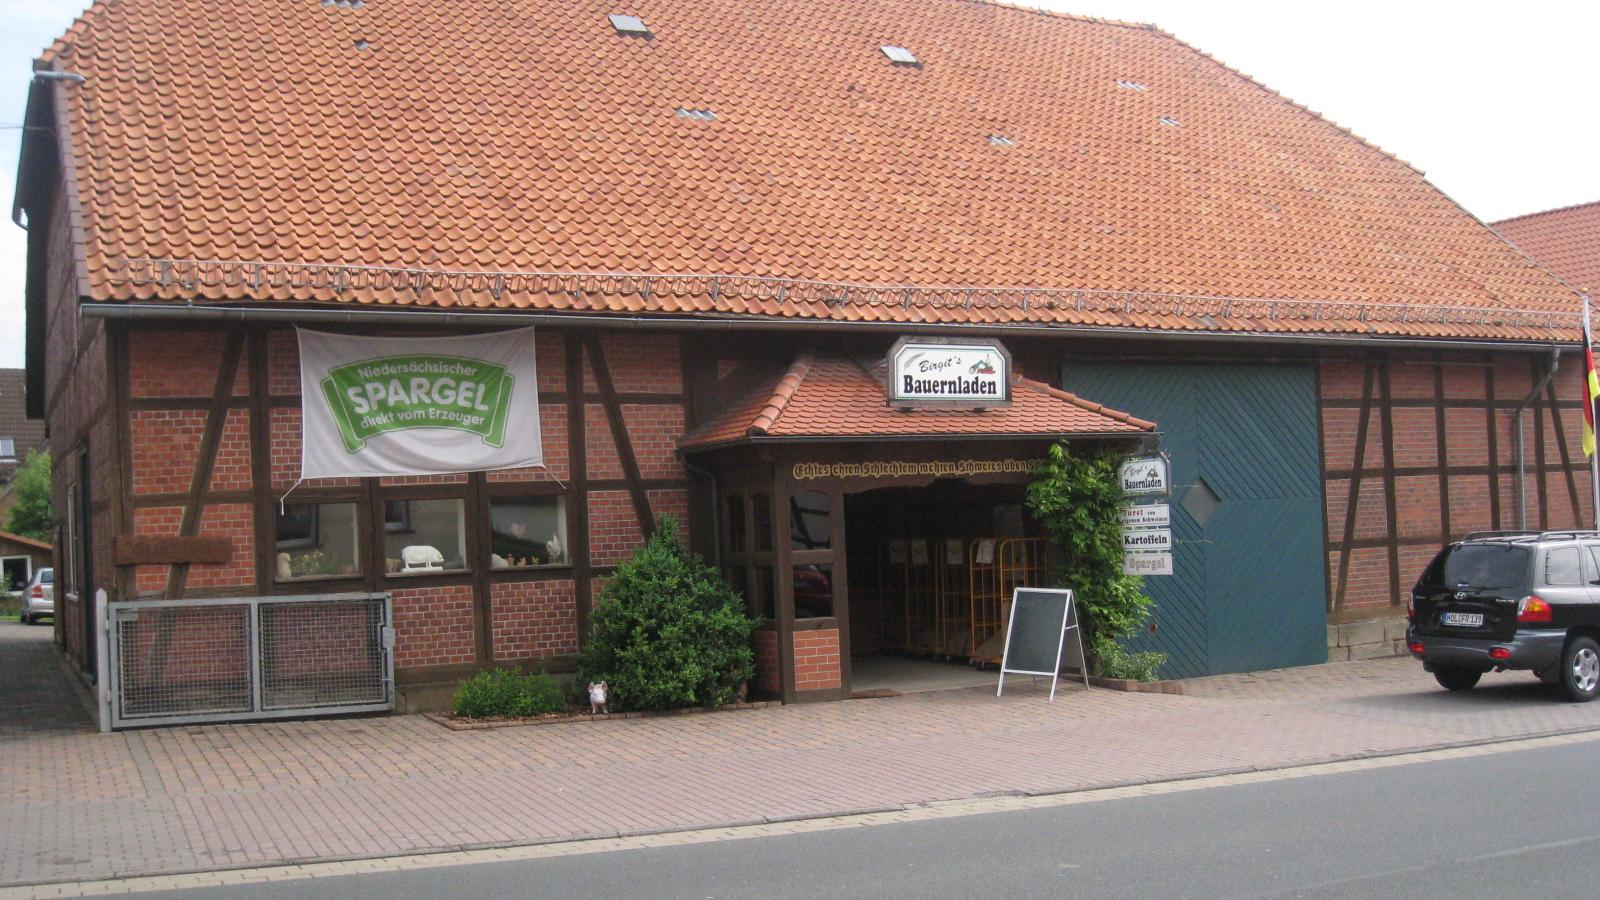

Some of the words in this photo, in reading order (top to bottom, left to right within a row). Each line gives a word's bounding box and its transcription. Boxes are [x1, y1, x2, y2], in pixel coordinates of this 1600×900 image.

[358, 361, 478, 378] Niedersächsischer
[903, 375, 997, 394] Bauernladen
[347, 377, 489, 414] SPARGEL
[361, 413, 395, 428] direkt
[399, 410, 426, 420] vom
[428, 408, 485, 425] Erzeuger
[1124, 478, 1162, 489] Bauernladen
[1124, 534, 1168, 545] Kartoffeln
[1129, 557, 1165, 571] Spargel
